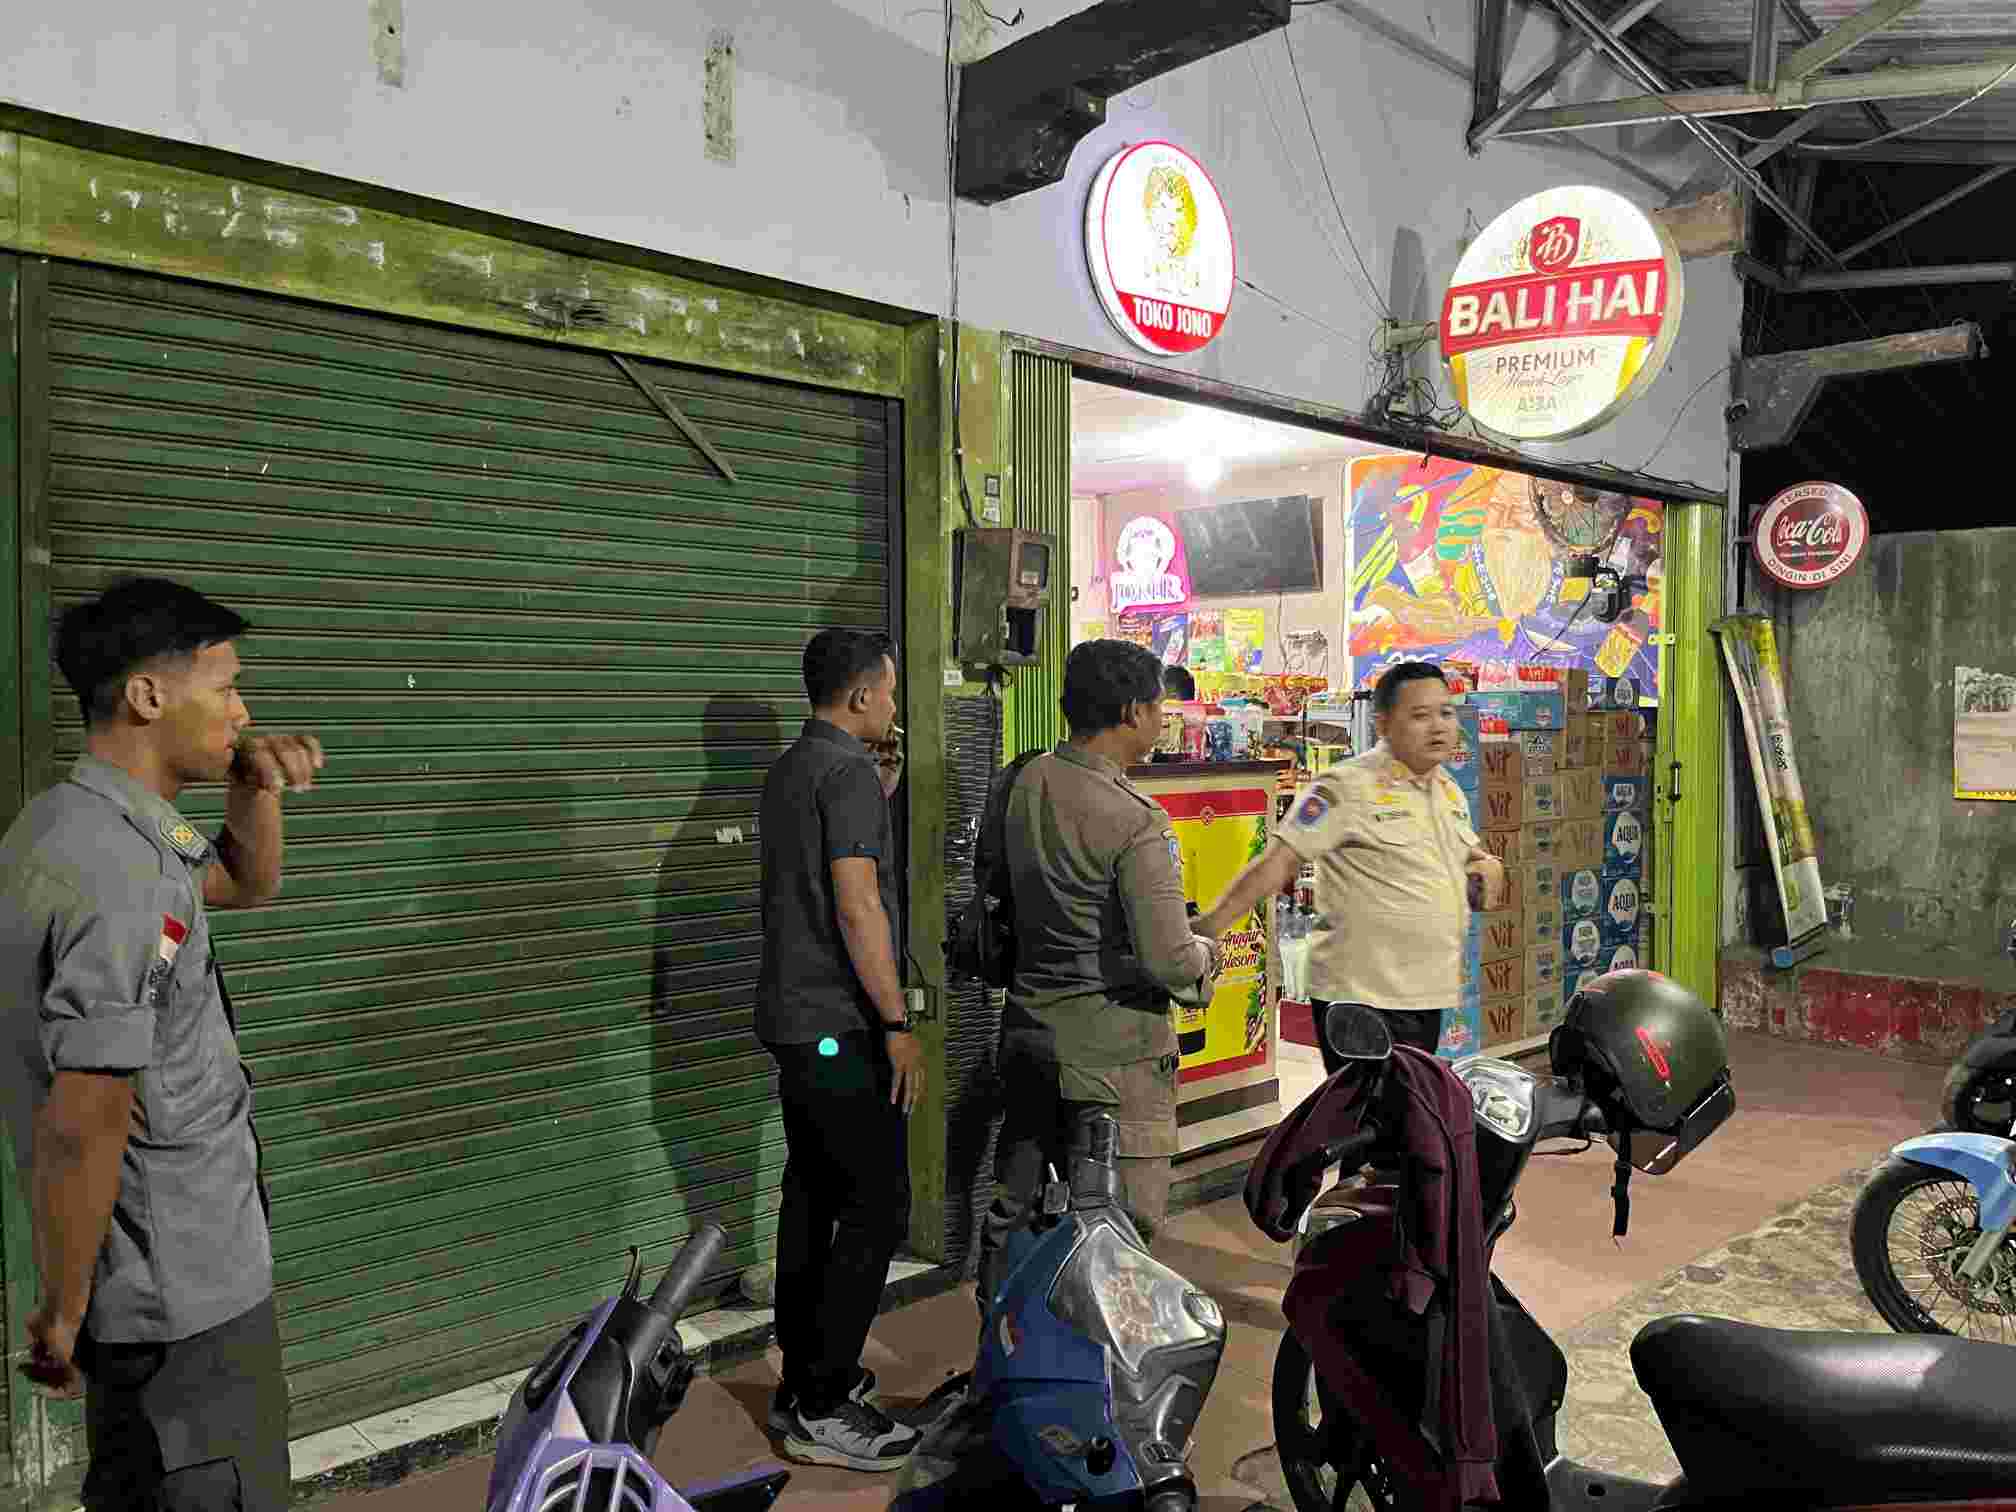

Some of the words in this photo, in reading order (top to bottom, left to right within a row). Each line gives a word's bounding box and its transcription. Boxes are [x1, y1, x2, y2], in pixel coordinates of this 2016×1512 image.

[1134, 298, 1174, 330] TOKO
[1176, 308, 1213, 338] JONO
[1449, 286, 1555, 337] BALI
[1565, 271, 1660, 322] HAI
[1495, 347, 1596, 375] PREMIUM
[1767, 558, 1807, 581] DINGIN
[1830, 553, 1853, 575] SINI
[1487, 791, 1513, 819] Vit
[1616, 825, 1639, 843] AQUA
[1612, 893, 1636, 911] AQUA
[1488, 918, 1516, 949] Vit
[1222, 951, 1258, 969] olesom
[1485, 962, 1513, 992] Vit
[1487, 1004, 1516, 1034] Vit
